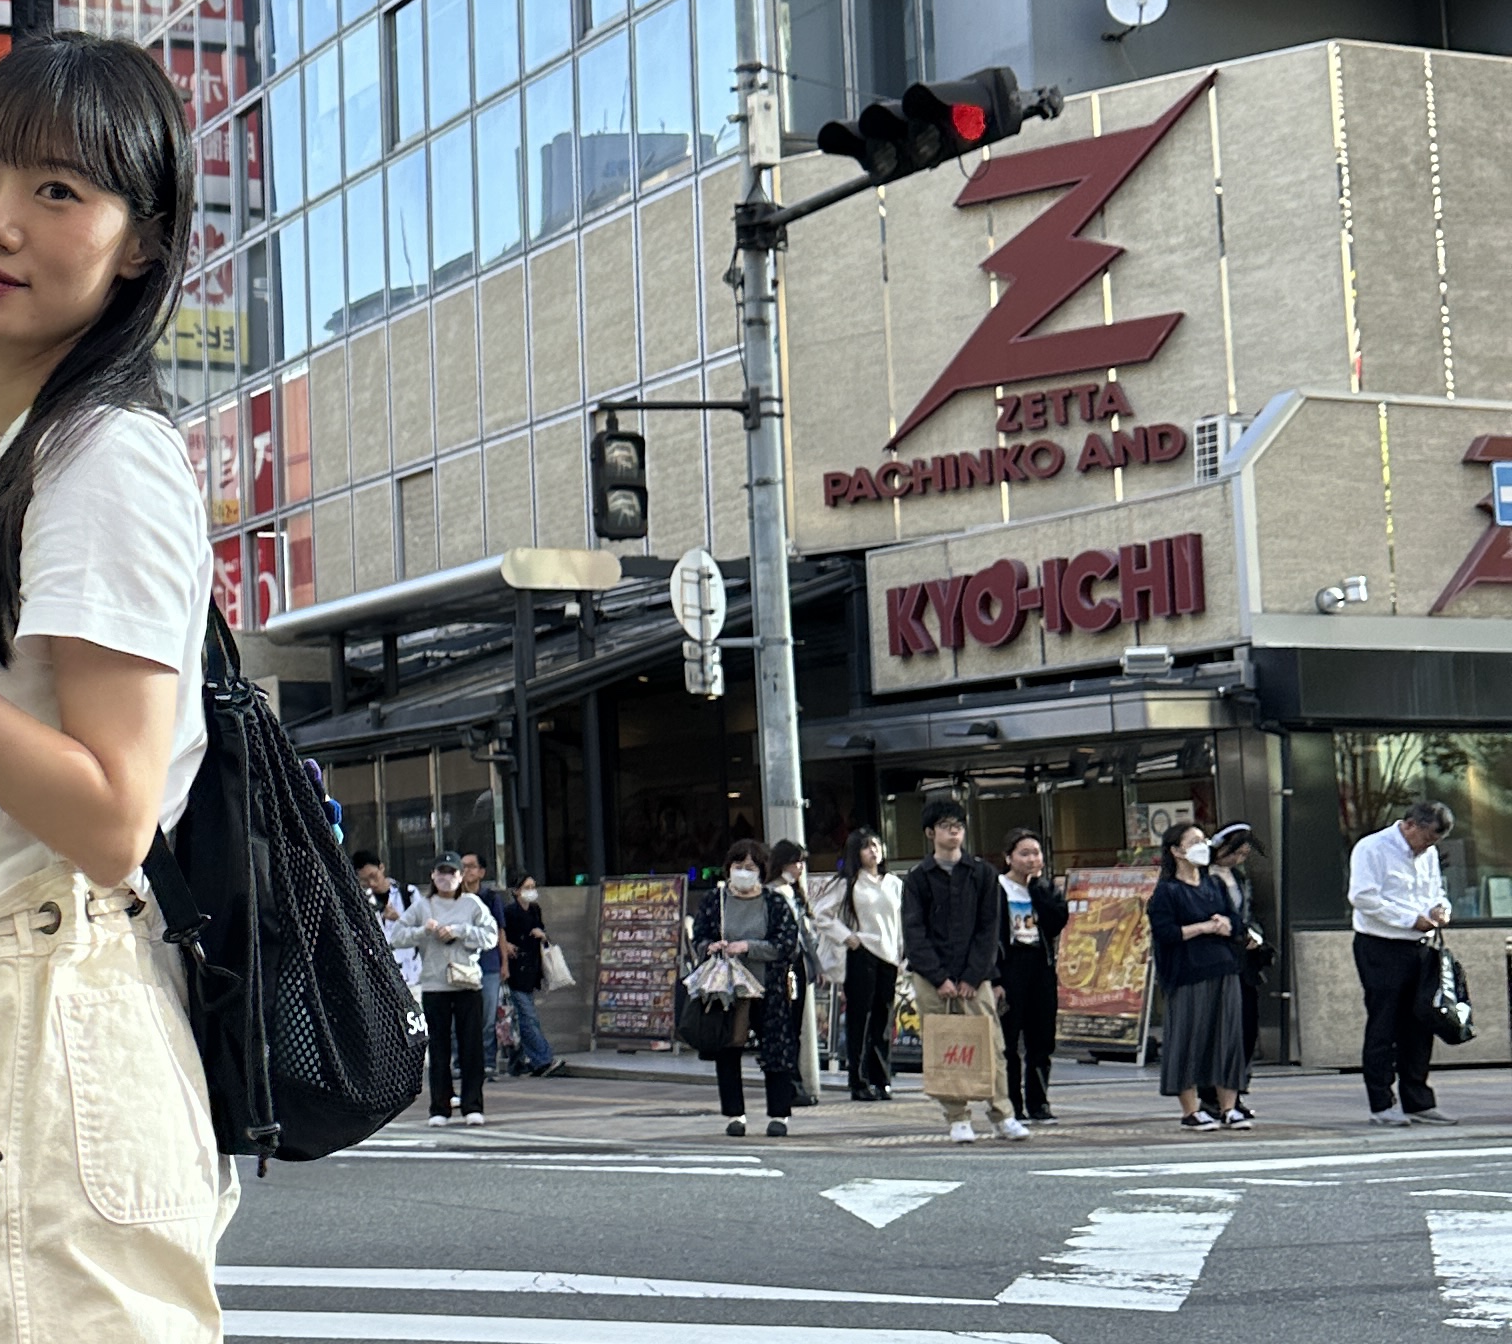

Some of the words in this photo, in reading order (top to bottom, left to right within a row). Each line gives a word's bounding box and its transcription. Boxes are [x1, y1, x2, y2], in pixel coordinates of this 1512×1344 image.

[996, 383, 1133, 434] ZETTA
[823, 436, 1066, 508] PACHINKO
[1077, 422, 1188, 475] AND
[887, 532, 1207, 659] KYO-ICHI
